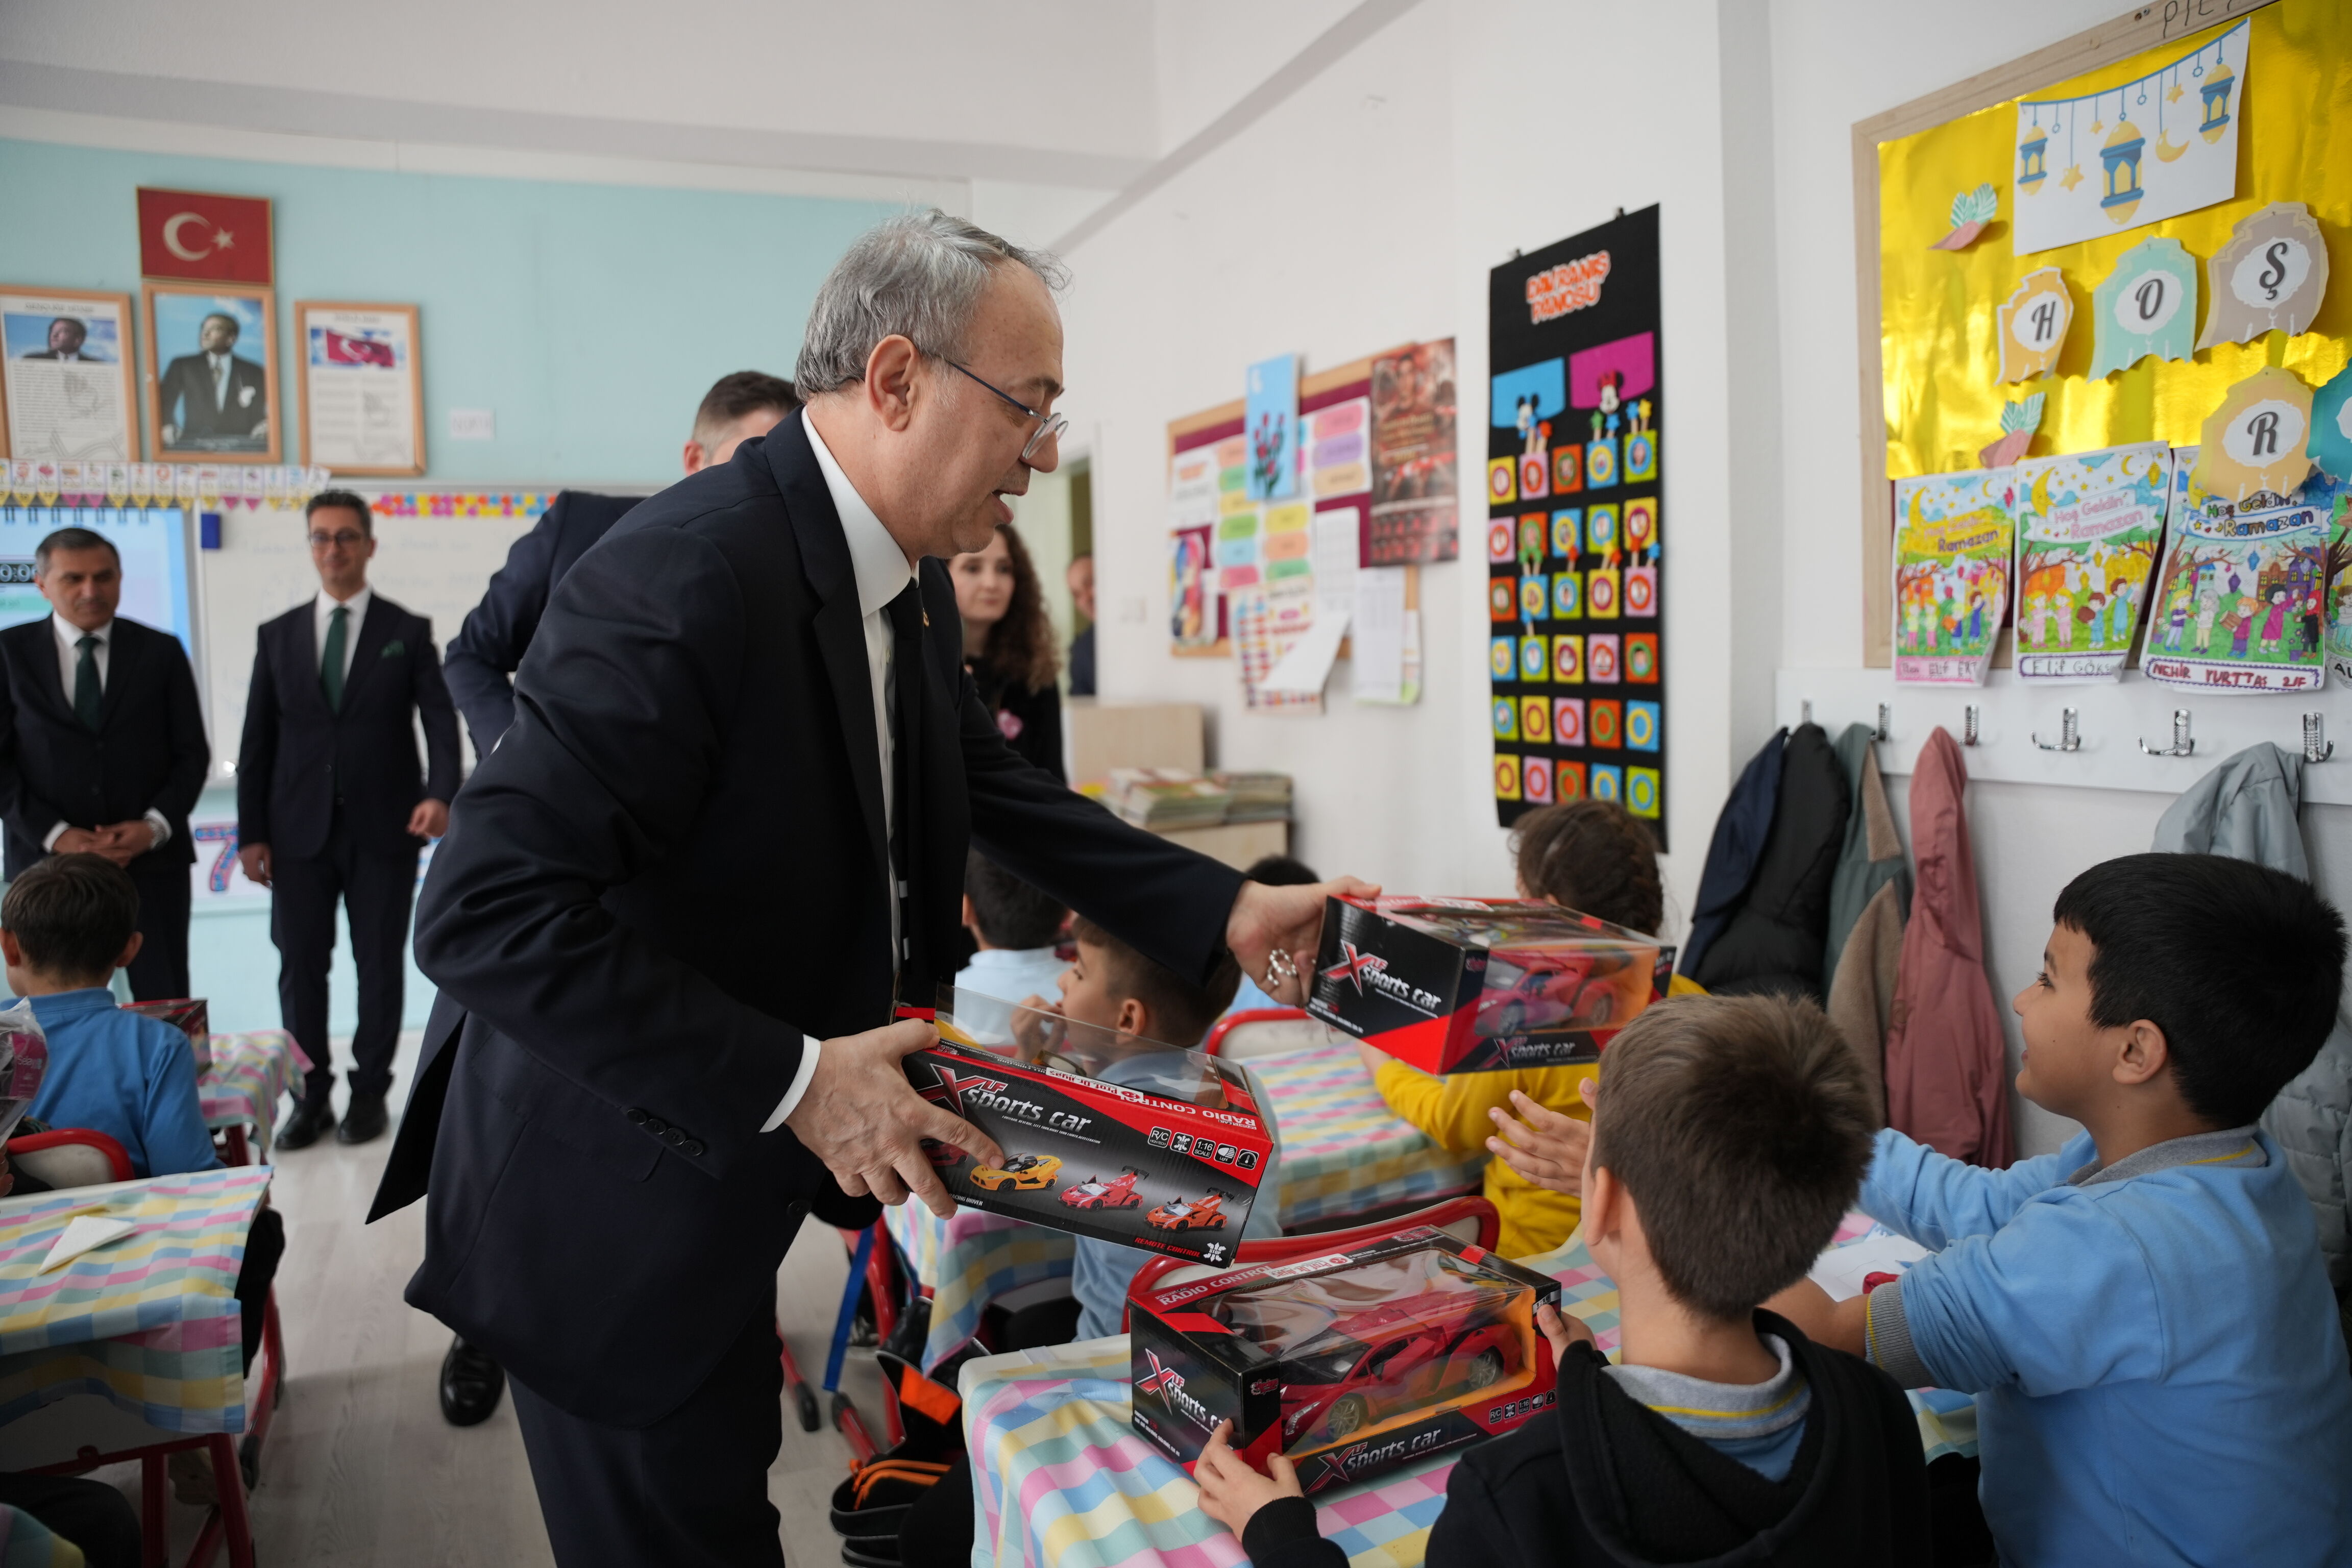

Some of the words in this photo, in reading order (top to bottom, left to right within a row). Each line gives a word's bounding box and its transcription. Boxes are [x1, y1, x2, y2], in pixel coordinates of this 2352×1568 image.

[2071, 510, 2143, 539] Ramazan
[2224, 510, 2314, 537] Ramazan
[1938, 530, 1999, 552] Ramazan
[1361, 965, 1410, 999] sports
[1412, 988, 1442, 1011] car
[964, 1088, 1044, 1122] sports
[1048, 1111, 1092, 1133] car
[1203, 1110, 1256, 1127] RADIO
[1150, 1130, 1169, 1141] R/C
[1194, 1149, 1211, 1158] SCALE
[1197, 1141, 1213, 1151] 1:16
[966, 1197, 983, 1206] DRIVER
[1134, 1237, 1167, 1249] REMOTE
[1166, 1245, 1200, 1258] CONTROL
[1159, 1285, 1208, 1305] RADIO
[1167, 1382, 1206, 1423] sports
[1519, 1400, 1529, 1409] 1:16
[1490, 1409, 1502, 1418] R/C
[1346, 1440, 1405, 1473] sports
[1411, 1429, 1441, 1450] car
